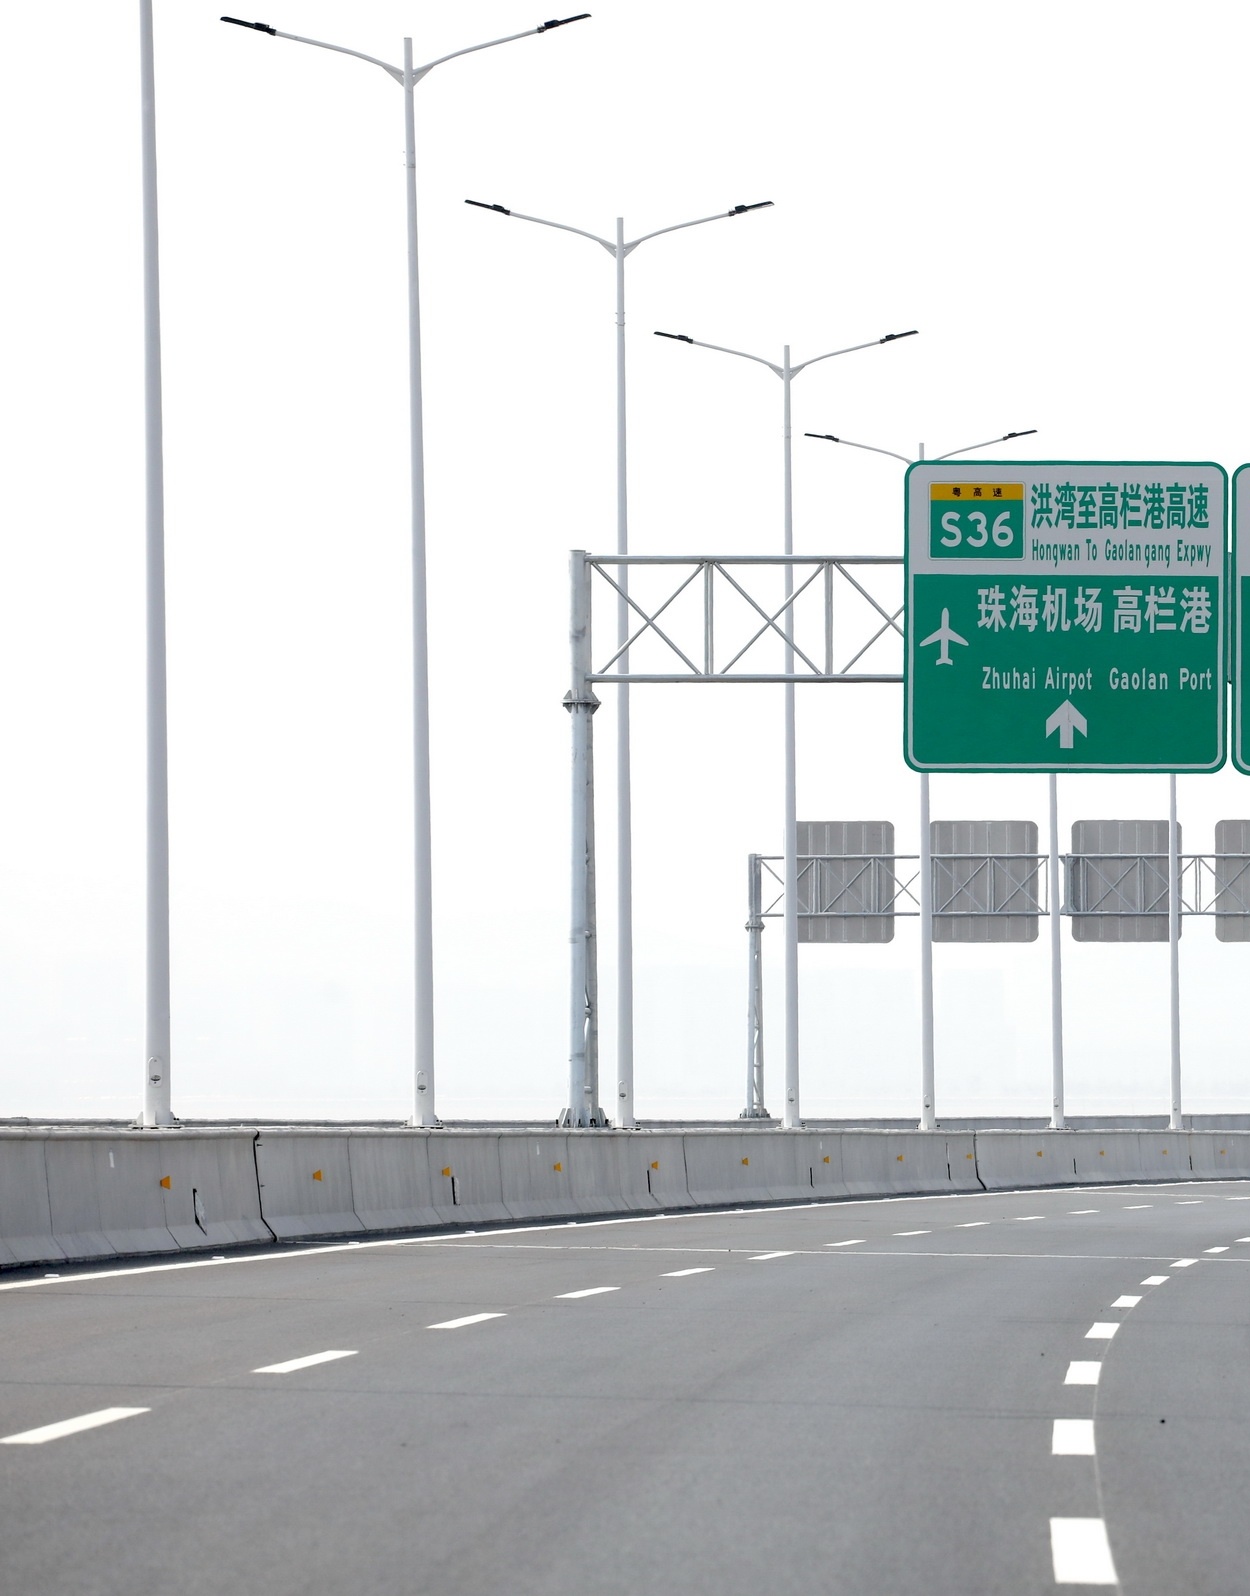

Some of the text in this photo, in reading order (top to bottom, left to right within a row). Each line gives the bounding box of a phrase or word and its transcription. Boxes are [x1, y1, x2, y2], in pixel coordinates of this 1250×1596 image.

[952, 487, 1003, 498] 粤高速
[1030, 482, 1210, 530] 洪湾至高栏港高速
[940, 511, 1014, 548] S36
[1032, 539, 1080, 568] Hongwan
[1086, 539, 1098, 560] To
[1177, 540, 1211, 568] Expwy
[977, 585, 1212, 634] 珠海机场 高栏港
[982, 667, 1212, 695] Zhuhai Airpot Gaolan Port
